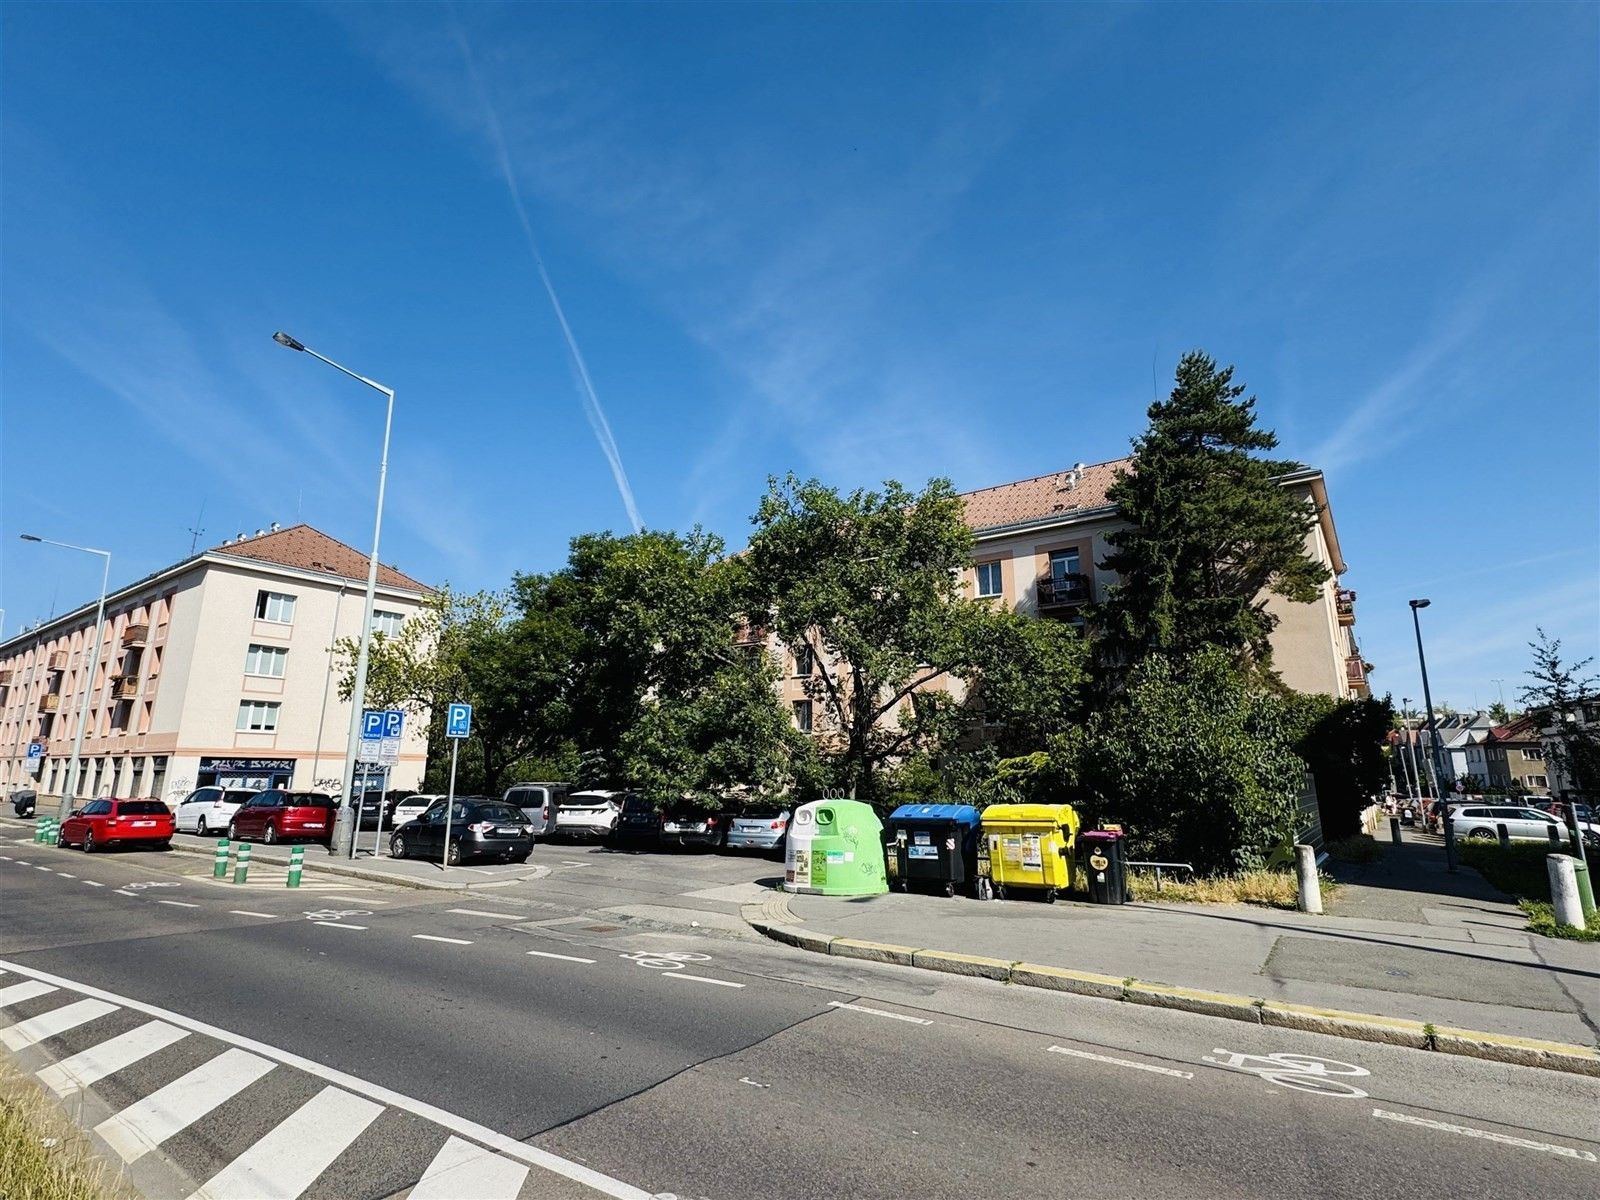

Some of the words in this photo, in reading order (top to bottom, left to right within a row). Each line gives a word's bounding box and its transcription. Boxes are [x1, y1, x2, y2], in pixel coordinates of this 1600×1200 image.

[367, 715, 381, 732] P
[387, 713, 399, 730] P
[453, 708, 466, 727] P
[30, 745, 40, 754] P
